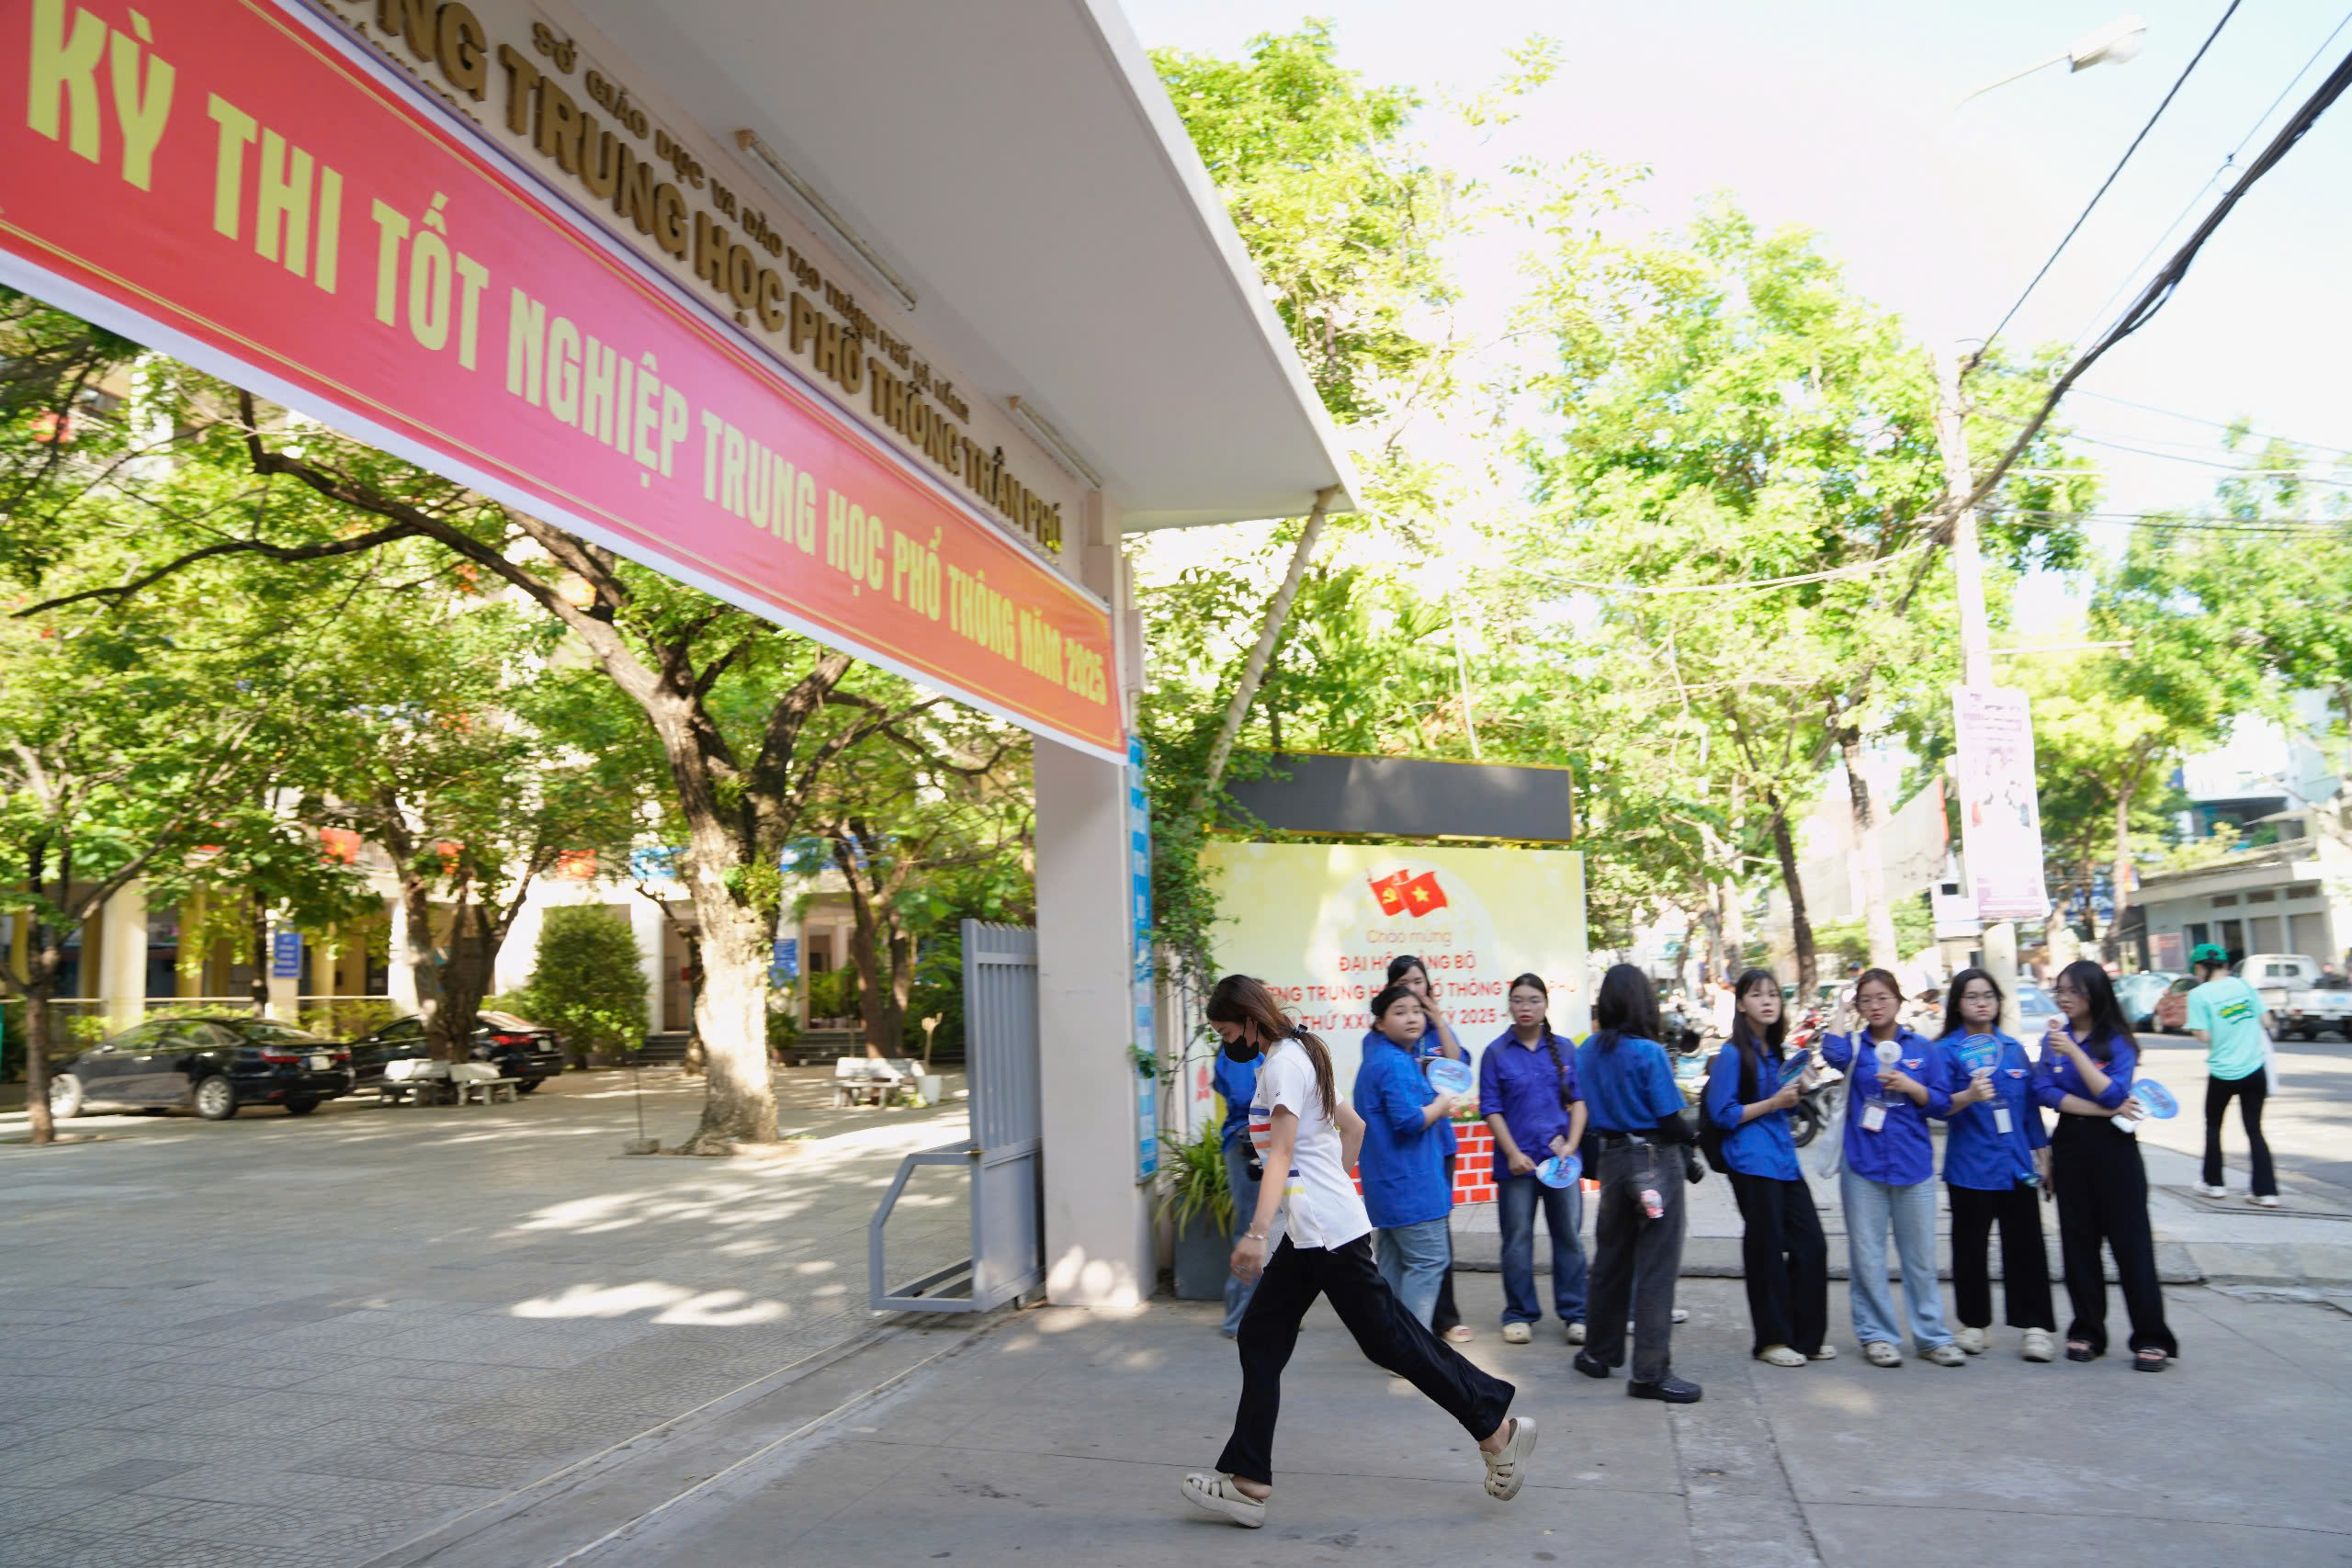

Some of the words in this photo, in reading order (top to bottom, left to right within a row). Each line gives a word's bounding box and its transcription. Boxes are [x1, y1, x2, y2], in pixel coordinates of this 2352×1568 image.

[532, 22, 576, 74] SỞ
[585, 70, 649, 140] GIÁO
[655, 129, 705, 189] DỤC
[786, 246, 820, 291] TẠO
[27, 0, 175, 192] KỲ
[208, 92, 344, 294] THI
[371, 191, 489, 372] TỐT
[506, 287, 688, 488] NGHIỆP
[701, 409, 817, 557] TRUNG
[827, 488, 884, 596] HỌC
[893, 525, 941, 622] PHỔ
[948, 563, 1015, 661] THÔNG
[1020, 606, 1063, 685] NĂM
[1066, 637, 1106, 705] 2025
[498, 44, 689, 262] TRUNG
[695, 210, 786, 332] HỌC
[867, 356, 961, 476] THÔNG
[962, 436, 1021, 525] TRẦN
[1023, 488, 1062, 553] PHÚ
[1303, 1010, 1339, 1031] THỨ
[1459, 1008, 1498, 1024] 2025
[1306, 985, 1365, 1002] TRUNG
[1447, 978, 1503, 998] THÔNG
[1339, 955, 1368, 975] ĐẠI
[1453, 950, 1476, 972] BỘ
